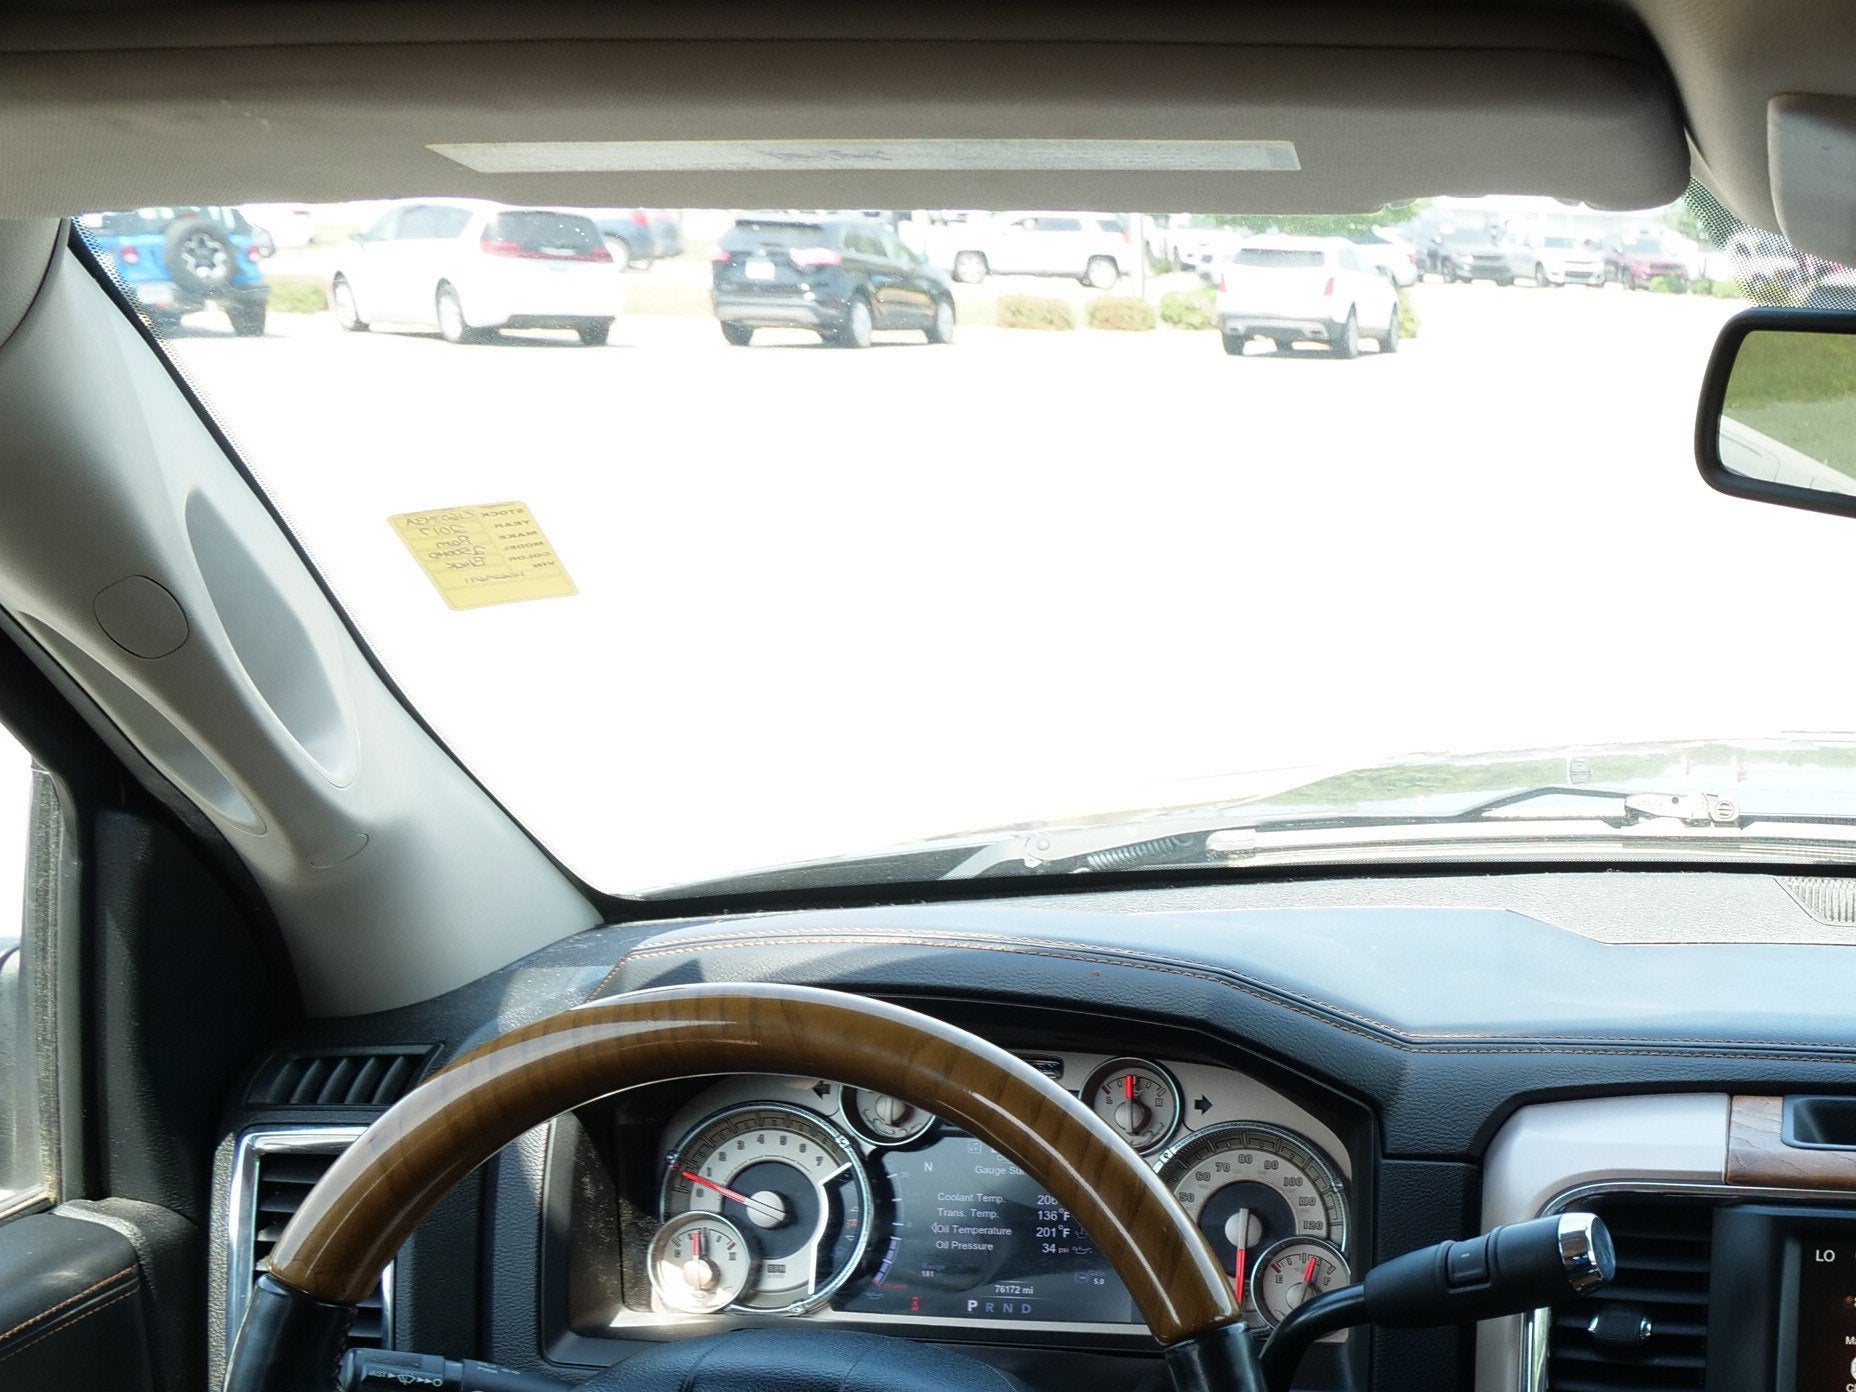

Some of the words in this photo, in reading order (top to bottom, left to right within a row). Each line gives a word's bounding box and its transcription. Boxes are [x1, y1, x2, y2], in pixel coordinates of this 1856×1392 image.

[1238, 1154, 1253, 1164] 80
[924, 1162, 933, 1172] N
[1215, 1162, 1230, 1172] 70
[1264, 1160, 1279, 1170] 90
[975, 1166, 1006, 1176] Gauge
[1196, 1172, 1211, 1182] 60
[1283, 1177, 1303, 1187] 100
[937, 1192, 974, 1202] Coolant
[977, 1194, 1006, 1203] Temp.
[1178, 1192, 1194, 1202] 50
[1299, 1196, 1316, 1207] 110
[970, 1208, 1000, 1219] Temp.
[936, 1224, 950, 1233] Oil
[952, 1225, 1012, 1236] Temperature
[1303, 1220, 1323, 1230] 120
[935, 1240, 949, 1249] Oil
[951, 1241, 994, 1251] Pressure
[1042, 1243, 1056, 1253] 34
[1815, 1249, 1836, 1262] LO
[1022, 1286, 1034, 1294] mi
[967, 1300, 978, 1312] P
[985, 1303, 994, 1312] R
[1002, 1303, 1013, 1313] N
[1021, 1303, 1032, 1314] D
